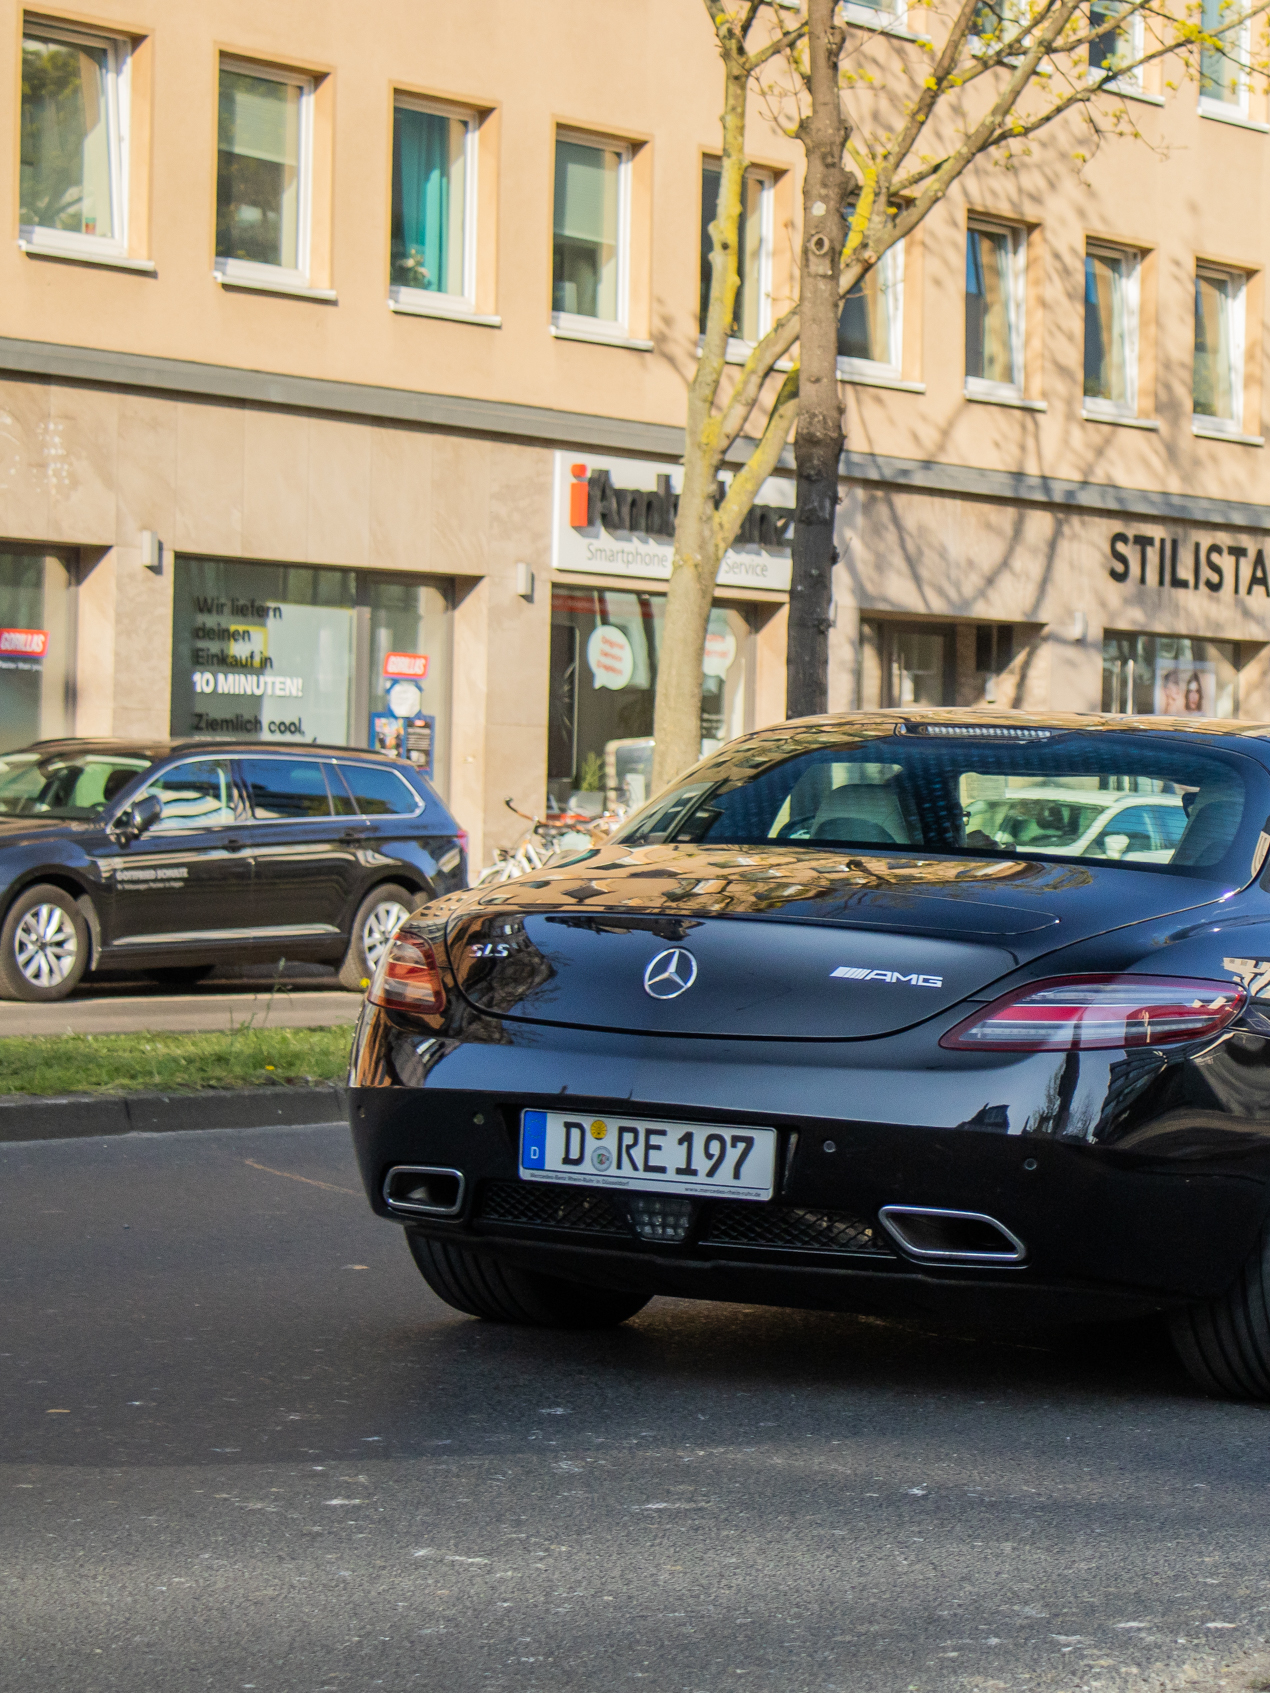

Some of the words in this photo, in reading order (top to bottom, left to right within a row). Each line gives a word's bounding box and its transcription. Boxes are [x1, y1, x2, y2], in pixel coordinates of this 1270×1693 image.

[587, 543, 668, 568] Smartphone
[724, 556, 768, 577] Service
[1109, 532, 1270, 598] STILISTA
[196, 597, 226, 615] Wir
[231, 598, 282, 619] liefern
[196, 623, 251, 642] deinen
[196, 648, 254, 667] Einkauf
[259, 651, 273, 669] in
[193, 672, 215, 693] 10
[217, 673, 303, 697] MINUTEN!
[195, 713, 263, 732] Ziemlich
[469, 943, 510, 957] SLS
[864, 969, 943, 988] AMG
[530, 1146, 540, 1159] D
[561, 1121, 586, 1166] D
